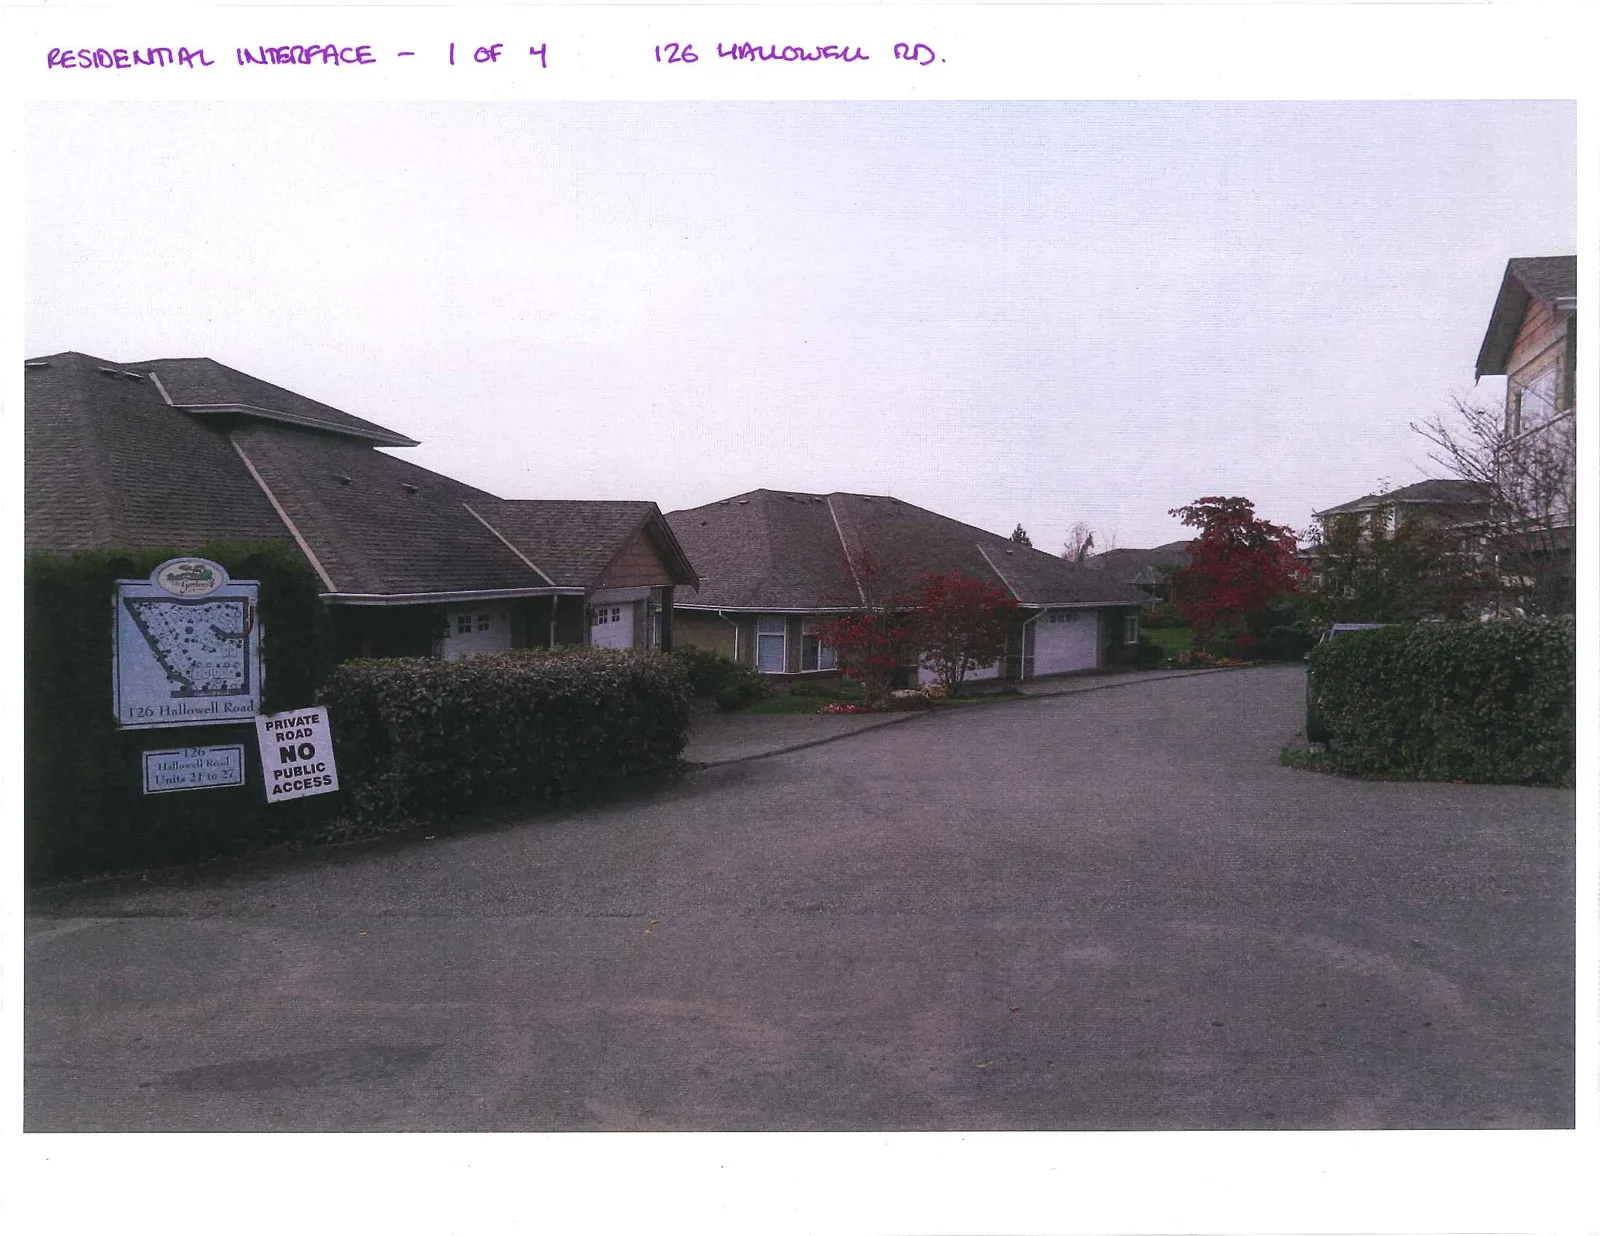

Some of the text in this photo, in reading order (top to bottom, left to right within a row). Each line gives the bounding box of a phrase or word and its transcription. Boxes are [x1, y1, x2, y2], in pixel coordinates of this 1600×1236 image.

[47, 47, 214, 69] RESIDENTIAL
[236, 43, 376, 66] INTERFACE
[473, 43, 503, 63] OF
[529, 44, 548, 68] 4
[655, 42, 699, 64] 126
[717, 42, 868, 63] HALLOWELL
[893, 42, 948, 66] RD.
[128, 699, 254, 719] 126 Hallowell Road
[265, 714, 320, 732] PRIVATE
[275, 727, 313, 742] ROAD
[183, 747, 206, 758] 126
[279, 742, 316, 764] NO
[158, 756, 231, 771] Hallowell Road
[273, 762, 326, 780] PUBLIC
[155, 769, 235, 785] Units 21 to 27
[272, 774, 333, 795] ACCESS
